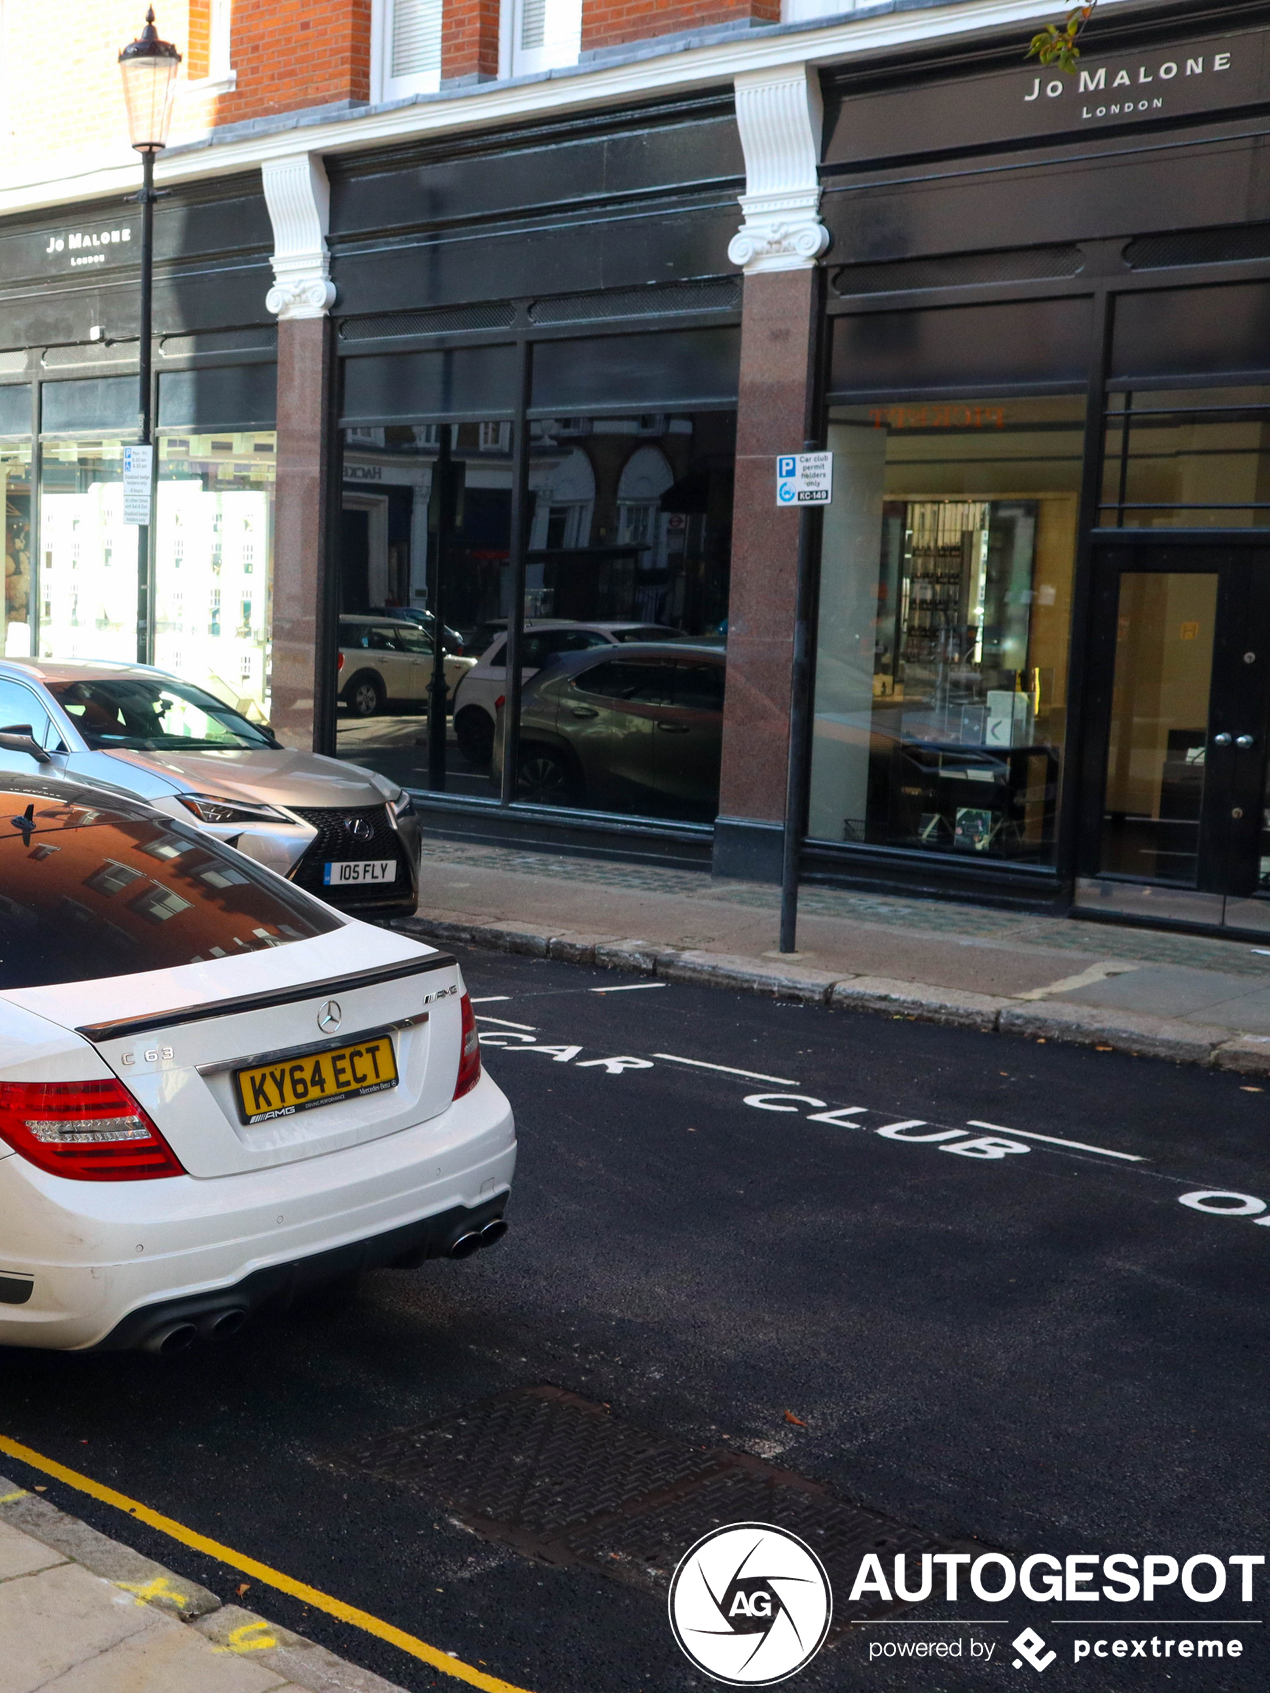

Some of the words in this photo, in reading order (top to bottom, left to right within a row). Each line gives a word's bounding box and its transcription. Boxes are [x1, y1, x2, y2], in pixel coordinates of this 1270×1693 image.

[1078, 52, 1231, 93] MALONE
[1082, 97, 1163, 119] LONDON
[68, 228, 131, 250] MALONE
[70, 254, 105, 266] LONDON
[802, 463, 825, 471] permit
[363, 863, 388, 880] FLY
[121, 1052, 136, 1065] C
[144, 1047, 174, 1063] 63
[478, 1032, 655, 1074] CAR
[250, 1060, 326, 1111] KY64
[331, 1045, 380, 1089] ECT
[262, 1105, 296, 1122] AMG
[359, 1081, 391, 1095] Mercedes-Benz
[743, 1093, 1031, 1159] CLUB
